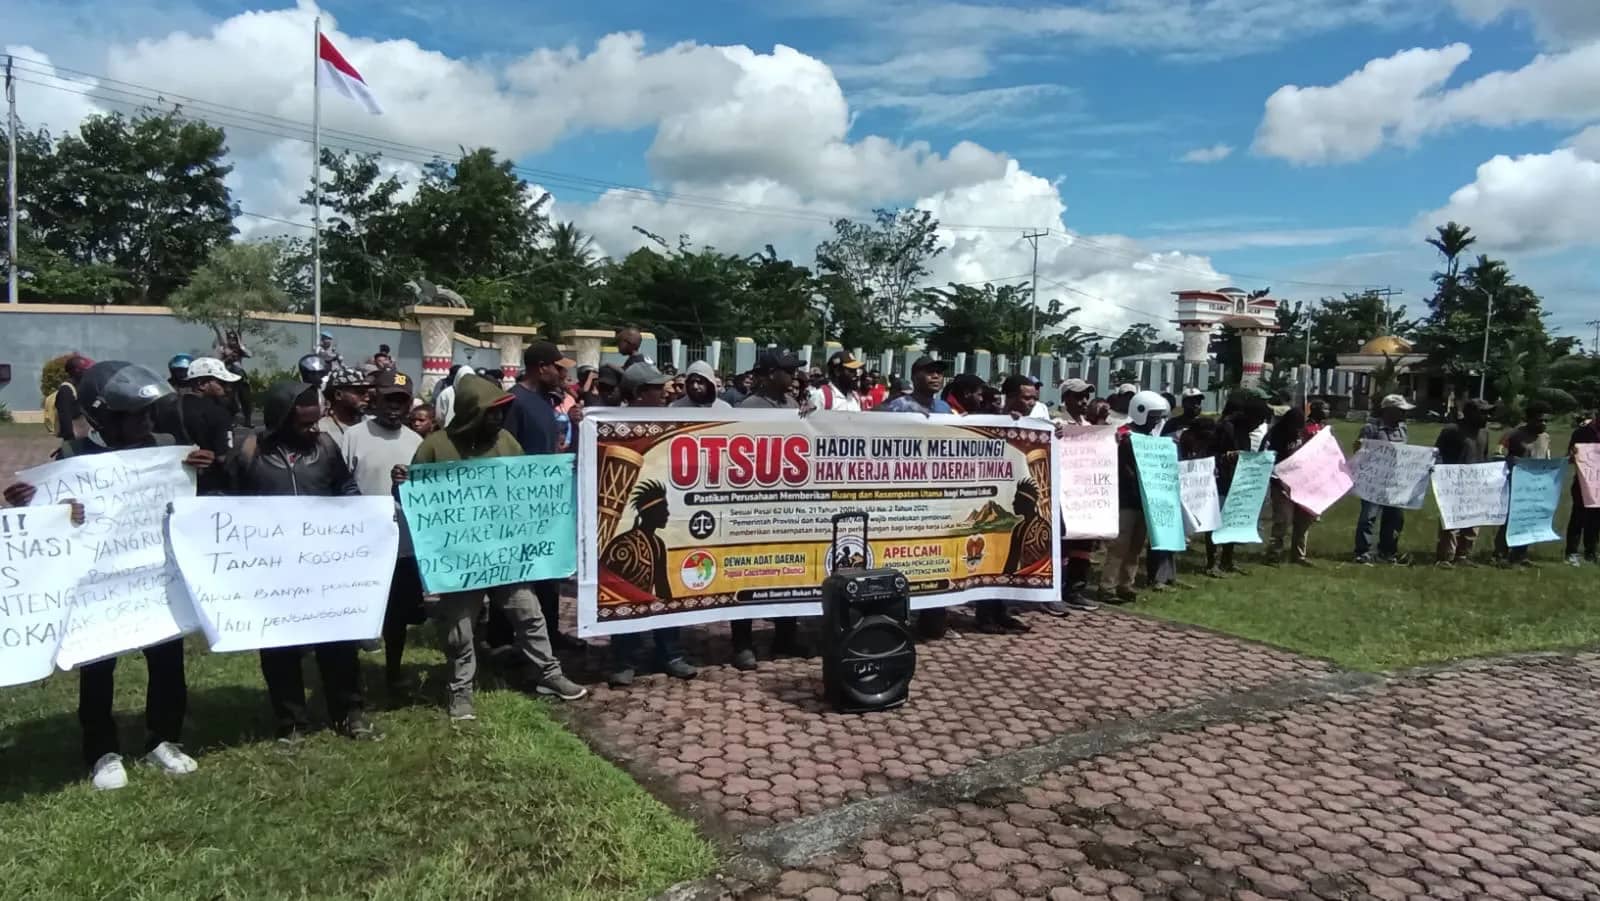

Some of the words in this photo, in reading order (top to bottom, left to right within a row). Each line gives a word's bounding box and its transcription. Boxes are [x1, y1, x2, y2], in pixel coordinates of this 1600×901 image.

[816, 438, 866, 457] HADIR
[871, 439, 922, 457] UNTUK
[927, 439, 1005, 457] MELINDUNGI
[505, 463, 562, 481] KARYA
[670, 435, 810, 488] OTSUS
[815, 462, 843, 481] HAK
[848, 462, 890, 481] KERJA
[894, 462, 928, 480] ANAK
[932, 461, 976, 480] DAERAH
[978, 461, 1013, 479] TIMIKA
[408, 485, 498, 508] MAIMATA
[507, 484, 564, 502] KEMANI
[693, 493, 729, 503] Pastikan
[731, 492, 779, 502] Perusahaan
[780, 491, 830, 500] Memberikan
[832, 490, 857, 500] Ruang
[858, 490, 873, 498] dan
[210, 511, 285, 550] PAPUA
[302, 521, 364, 537] BUKAN
[417, 506, 467, 532] NARE
[443, 523, 493, 549] NARE
[500, 519, 549, 540] IWATE
[5, 537, 71, 561] NASI
[203, 551, 282, 574] TANAH
[299, 545, 370, 565] KOSONG
[723, 556, 752, 567] DEWAN
[753, 555, 773, 565] ADAT
[774, 553, 806, 564] DAERAH
[883, 545, 942, 559] APELCAMI
